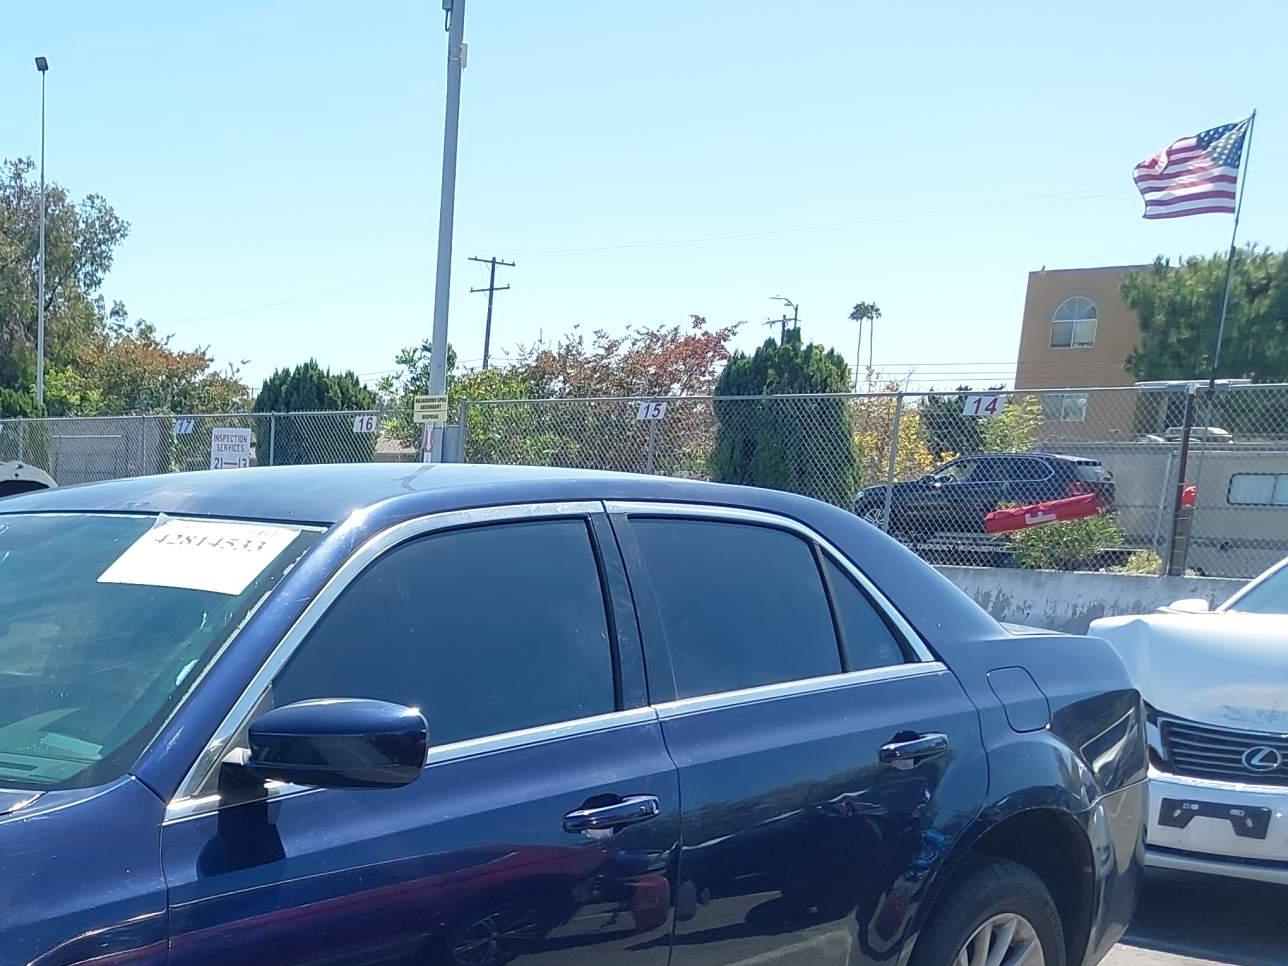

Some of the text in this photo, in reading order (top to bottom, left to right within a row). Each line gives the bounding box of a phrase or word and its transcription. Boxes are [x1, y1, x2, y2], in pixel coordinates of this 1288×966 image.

[643, 403, 662, 418] 15
[972, 397, 998, 415] 14
[178, 419, 192, 433] 17
[359, 417, 373, 431] 16
[213, 433, 248, 443] INSPECTION
[216, 443, 245, 452] SERVICES
